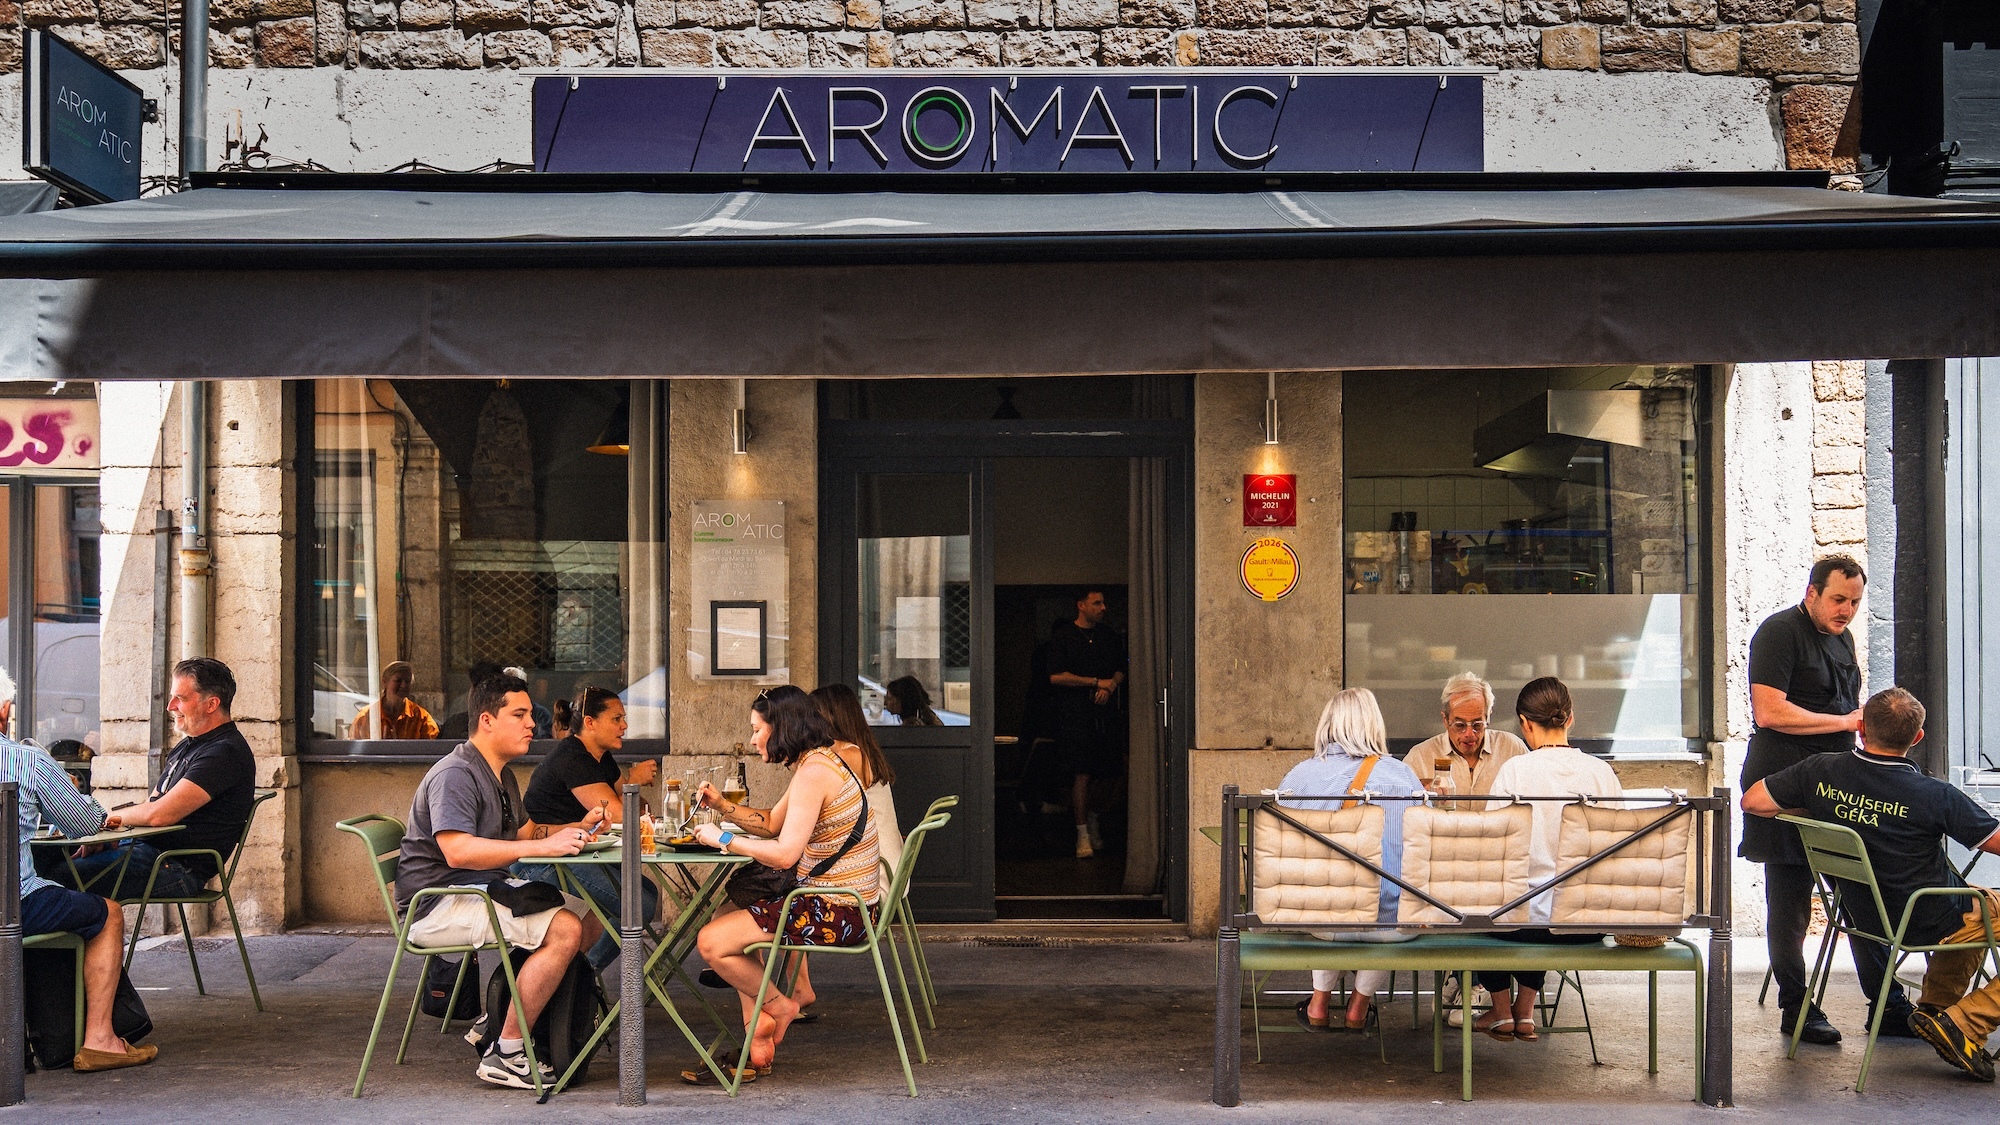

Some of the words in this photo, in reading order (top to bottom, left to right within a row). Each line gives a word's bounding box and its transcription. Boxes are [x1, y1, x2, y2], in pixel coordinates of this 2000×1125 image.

[57, 86, 107, 126] AROM
[743, 85, 1279, 163] AROMATIC
[99, 129, 131, 163] ATIC
[1250, 492, 1290, 500] MICHELIN
[1261, 501, 1279, 509] 2021
[693, 513, 751, 527] AROM
[742, 524, 783, 539] ATIC
[1257, 539, 1281, 548] 2026
